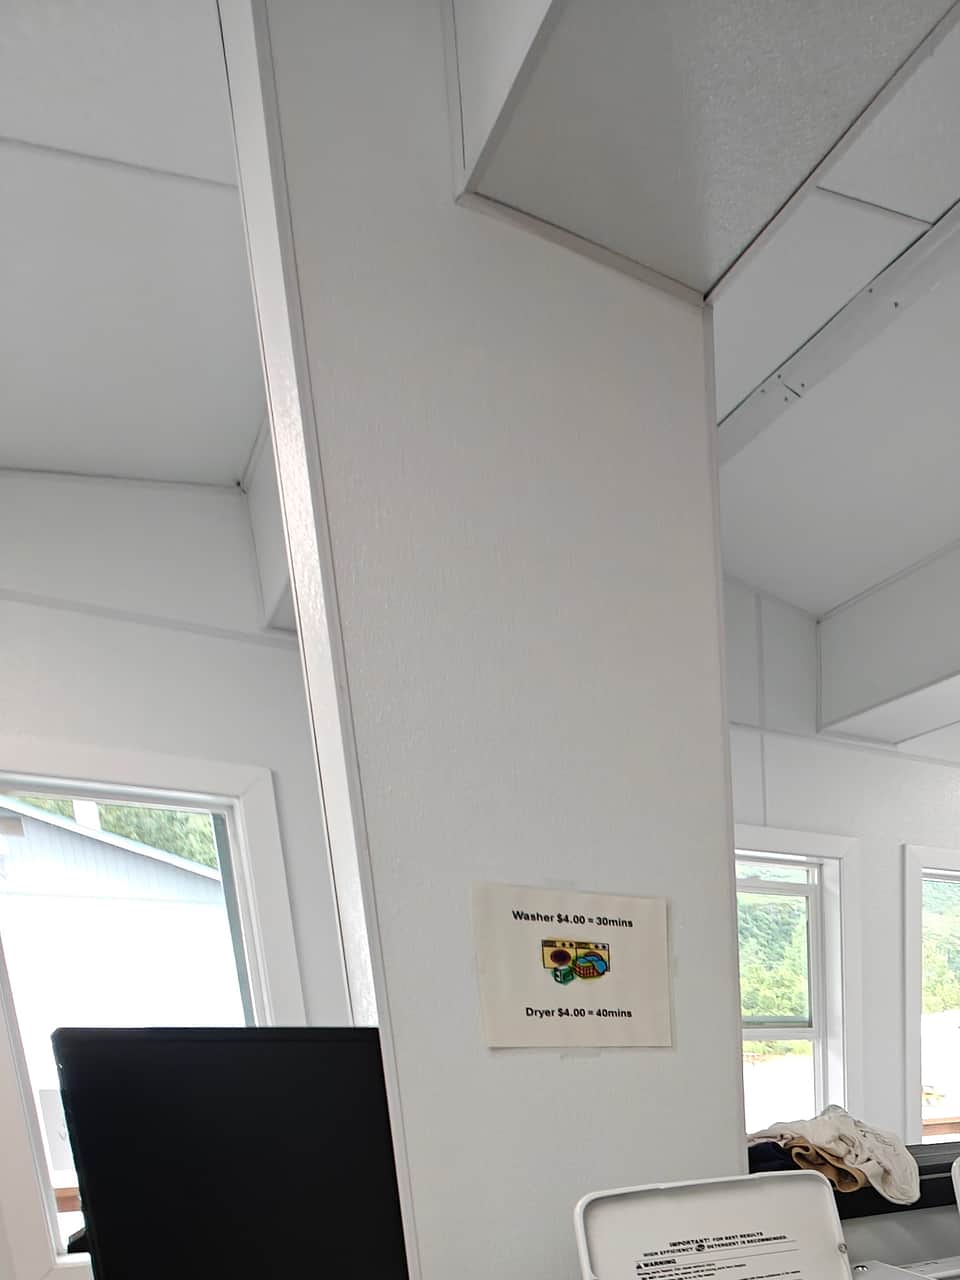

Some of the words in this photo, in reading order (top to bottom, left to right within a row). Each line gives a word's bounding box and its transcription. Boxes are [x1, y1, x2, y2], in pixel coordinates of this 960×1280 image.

[511, 909, 555, 923] Washer
[556, 912, 586, 925] $4.00
[595, 916, 634, 928] 30mins
[525, 1007, 555, 1019] Dryer
[557, 1008, 586, 1018] $4.00
[595, 1008, 633, 1018] 40mins
